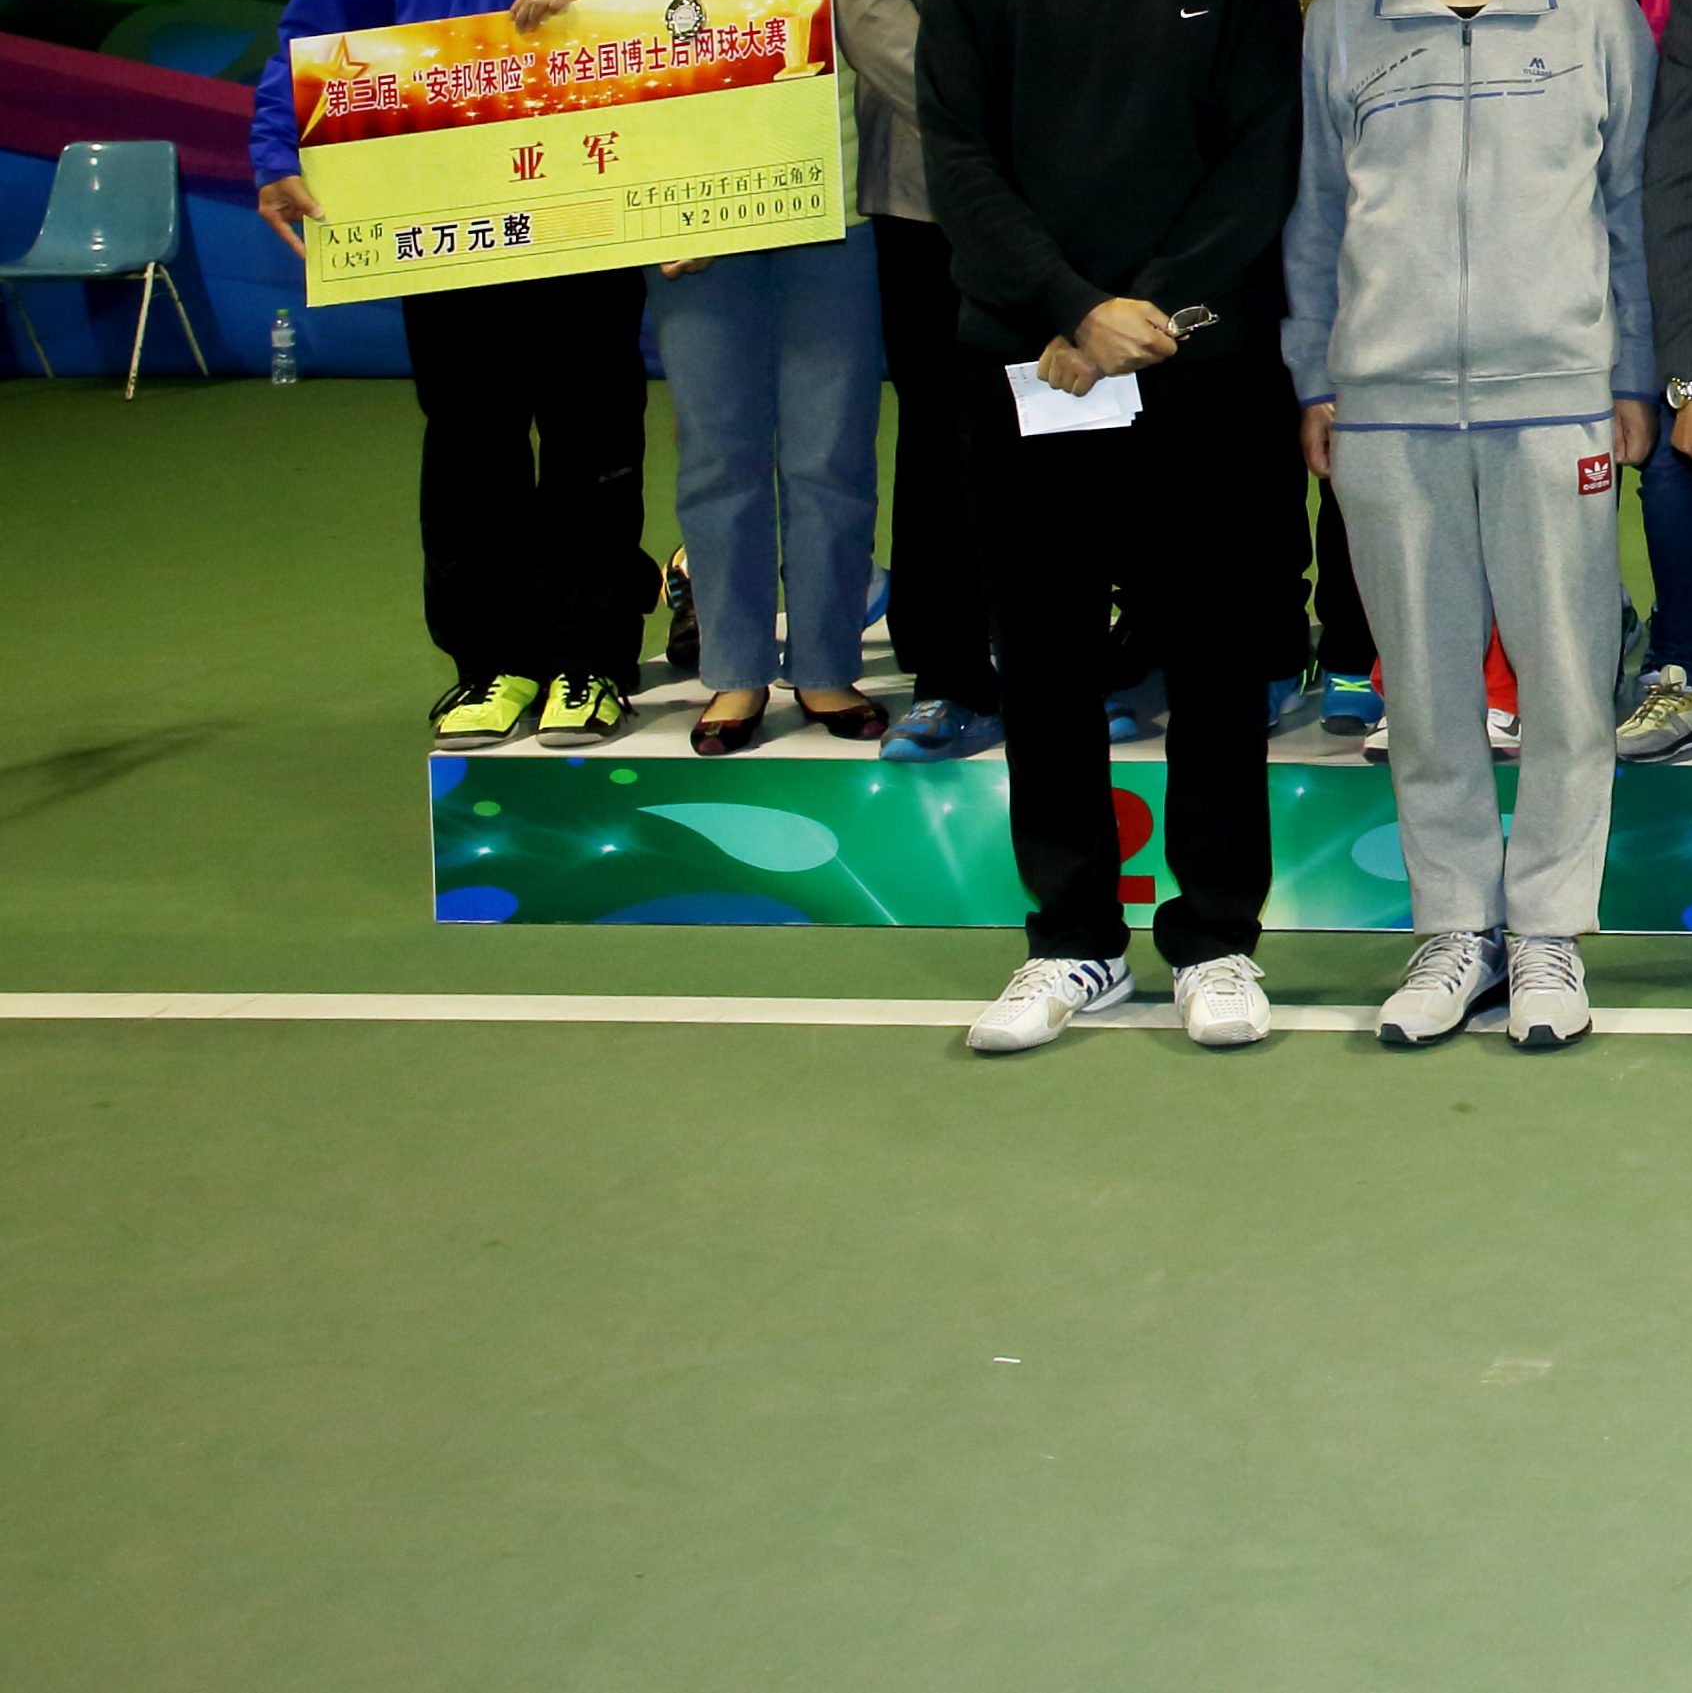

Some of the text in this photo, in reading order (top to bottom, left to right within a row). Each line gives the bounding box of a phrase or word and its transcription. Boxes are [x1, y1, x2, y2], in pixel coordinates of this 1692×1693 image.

[326, 17, 788, 116] 第三届 “安邦保险” 杯全国博士后网球大赛
[509, 130, 620, 183] 亚军
[327, 212, 532, 261] 人民币 贰万元整
